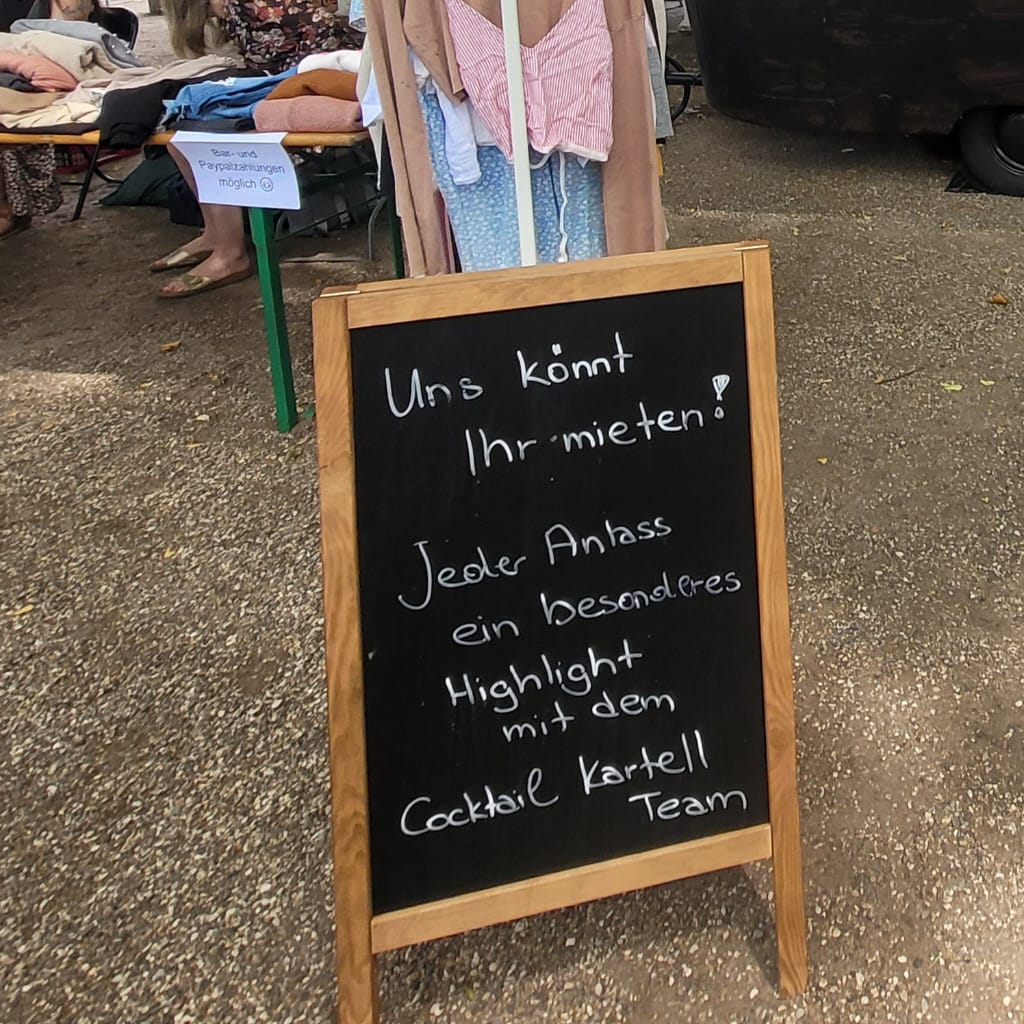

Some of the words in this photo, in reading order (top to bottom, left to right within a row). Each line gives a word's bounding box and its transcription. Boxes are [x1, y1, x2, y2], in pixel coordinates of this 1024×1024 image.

[219, 176, 257, 190] möglich
[385, 368, 483, 417] Uns
[517, 332, 633, 388] könnt
[466, 429, 536, 475] Ihr
[399, 541, 526, 609] Jeder
[453, 616, 520, 646] ein
[541, 572, 741, 625] besonderes
[445, 638, 643, 715] Highlight
[501, 708, 575, 742] mit
[592, 691, 674, 717] dem
[401, 768, 558, 835] Cocktail
[629, 791, 746, 821] Team
